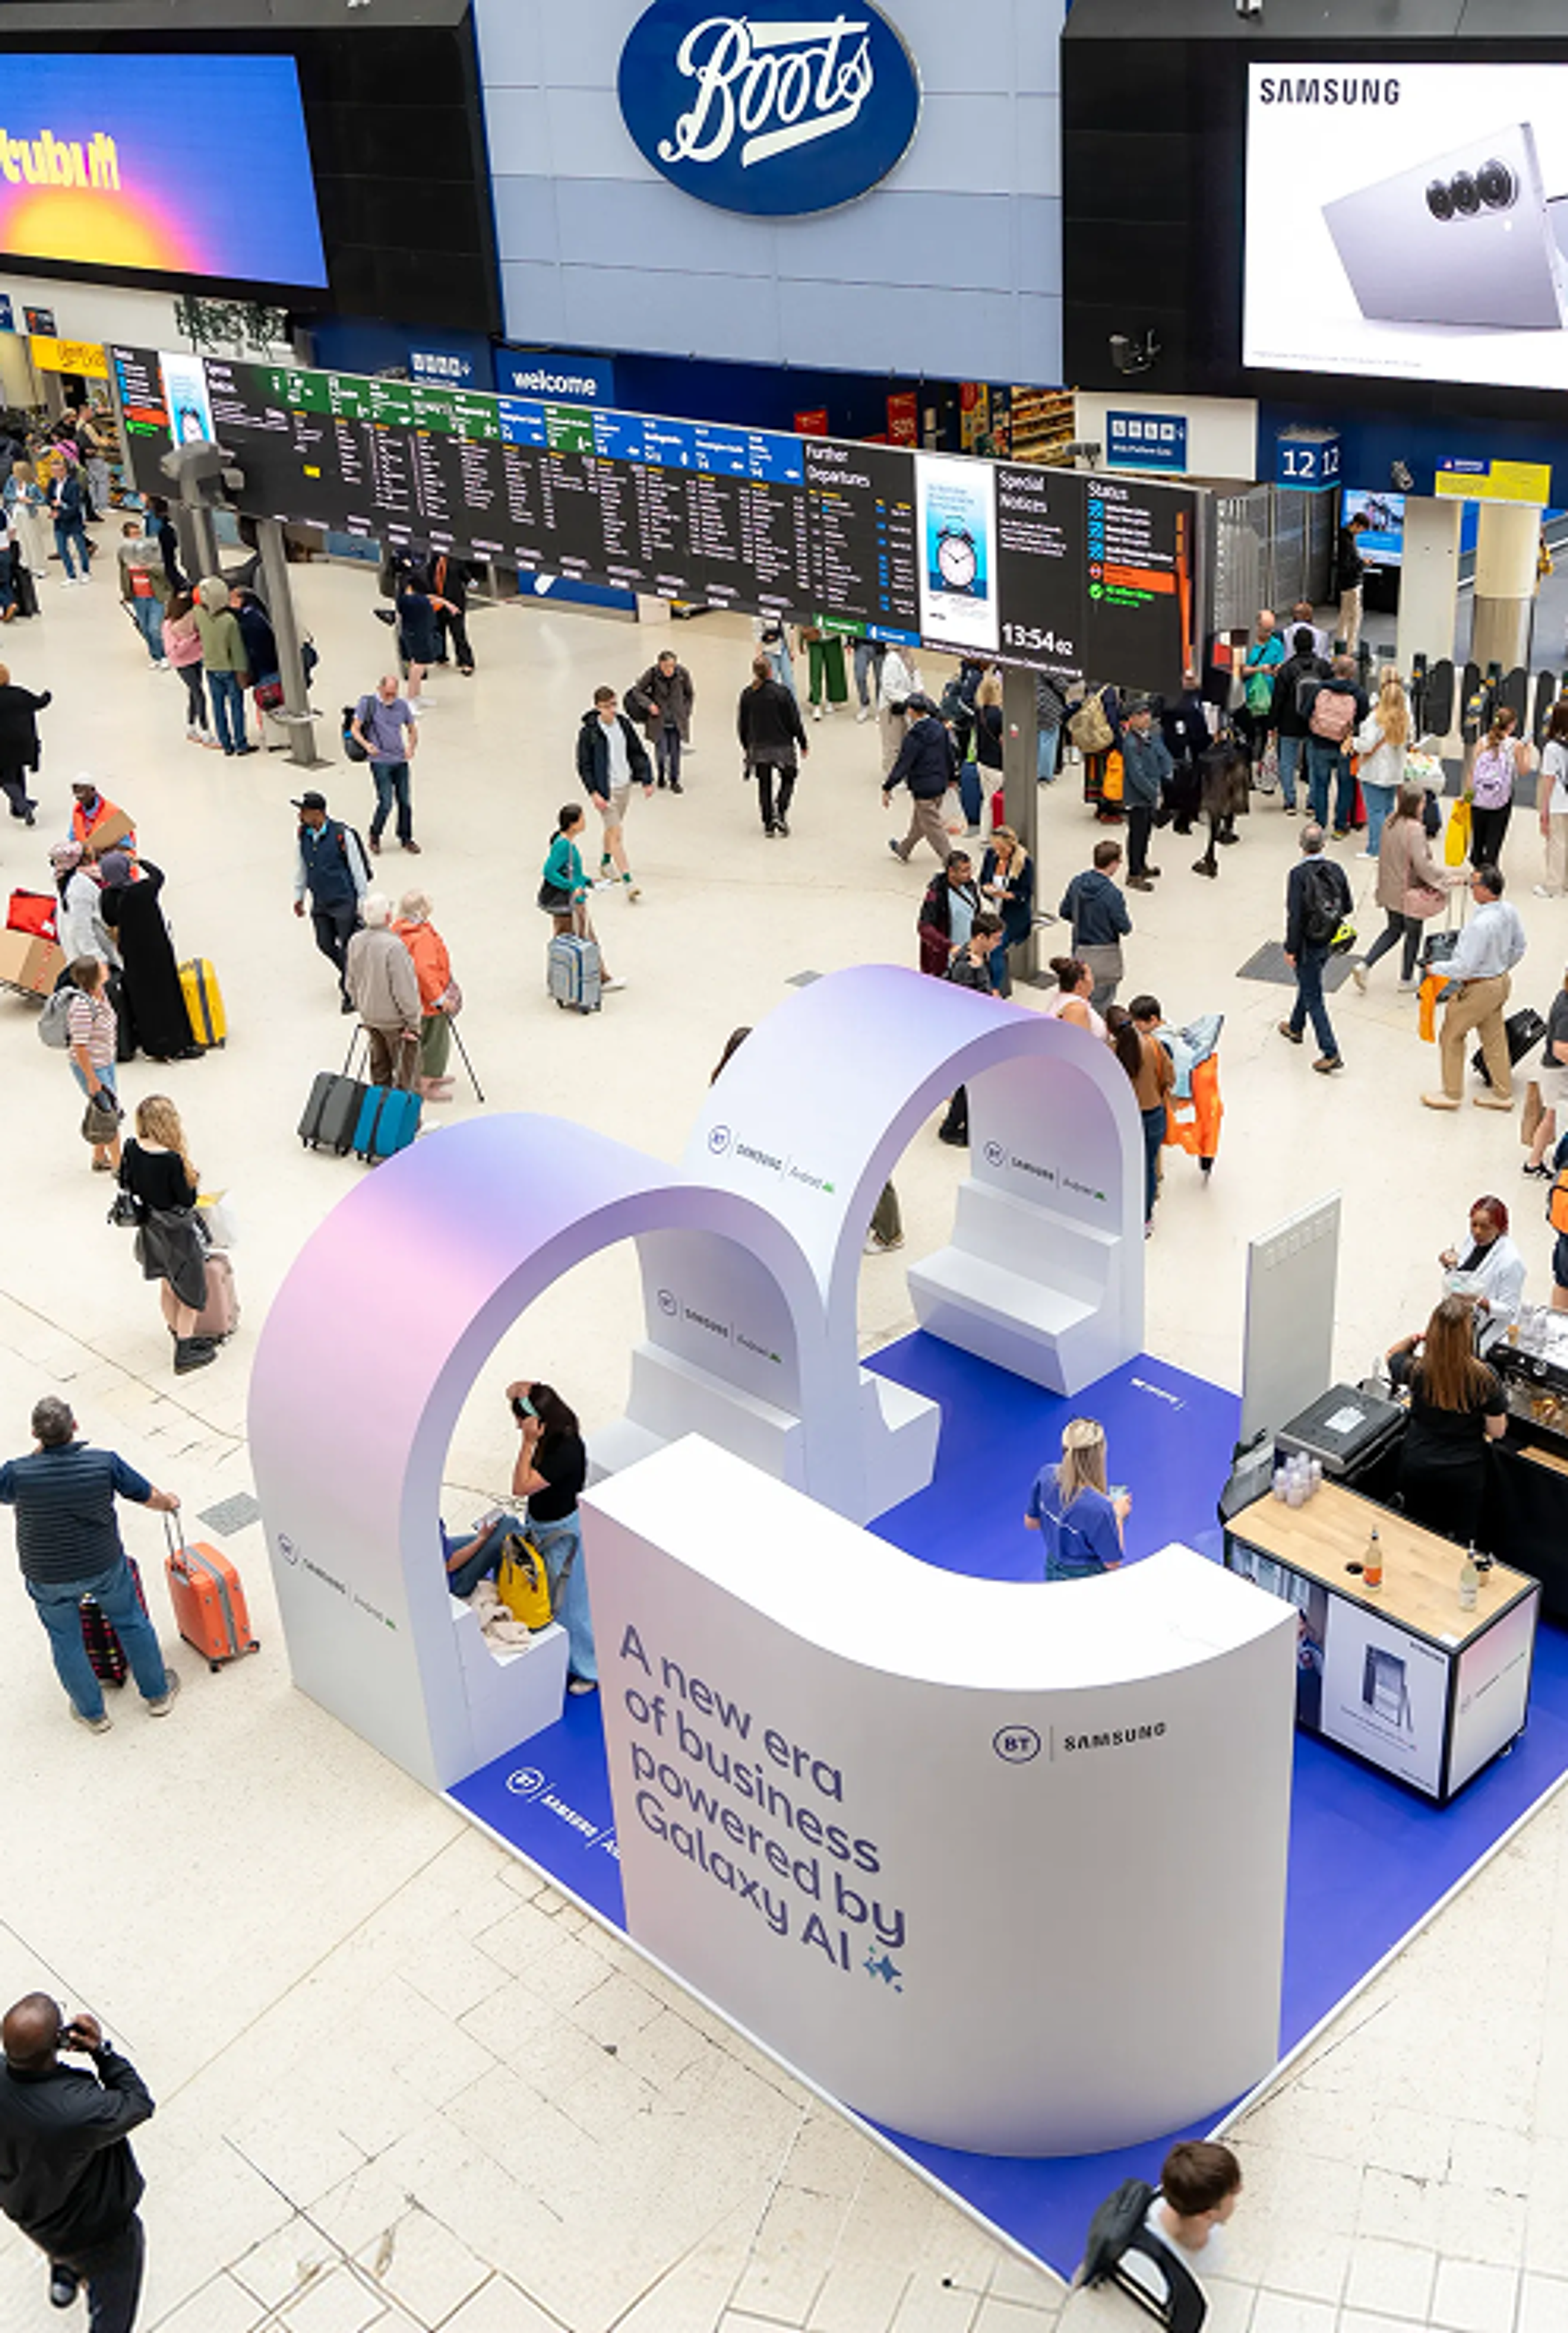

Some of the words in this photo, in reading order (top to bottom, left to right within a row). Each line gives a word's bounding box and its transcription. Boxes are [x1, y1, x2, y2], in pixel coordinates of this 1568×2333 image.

[656, 14, 875, 168] Boots
[1259, 77, 1401, 105] SAMSUNG
[512, 369, 597, 397] welcome
[806, 443, 849, 463] Further
[1283, 448, 1316, 478] 12
[1322, 447, 1339, 476] 12
[806, 464, 871, 488] Departures
[999, 470, 1045, 491] Special
[1087, 480, 1129, 501] Status
[999, 492, 1048, 513] Notices
[1002, 623, 1054, 652] 13:54
[619, 1624, 652, 1676] A
[661, 1655, 752, 1740] new
[764, 1726, 843, 1803] era
[1064, 1721, 1167, 1752] SAMSUNG
[624, 1687, 667, 1736] of
[676, 1709, 880, 1874] business
[631, 1741, 821, 1901] powered
[834, 1870, 906, 1948] by
[636, 1789, 788, 1937] Galaxy
[801, 1912, 851, 1972] AI
